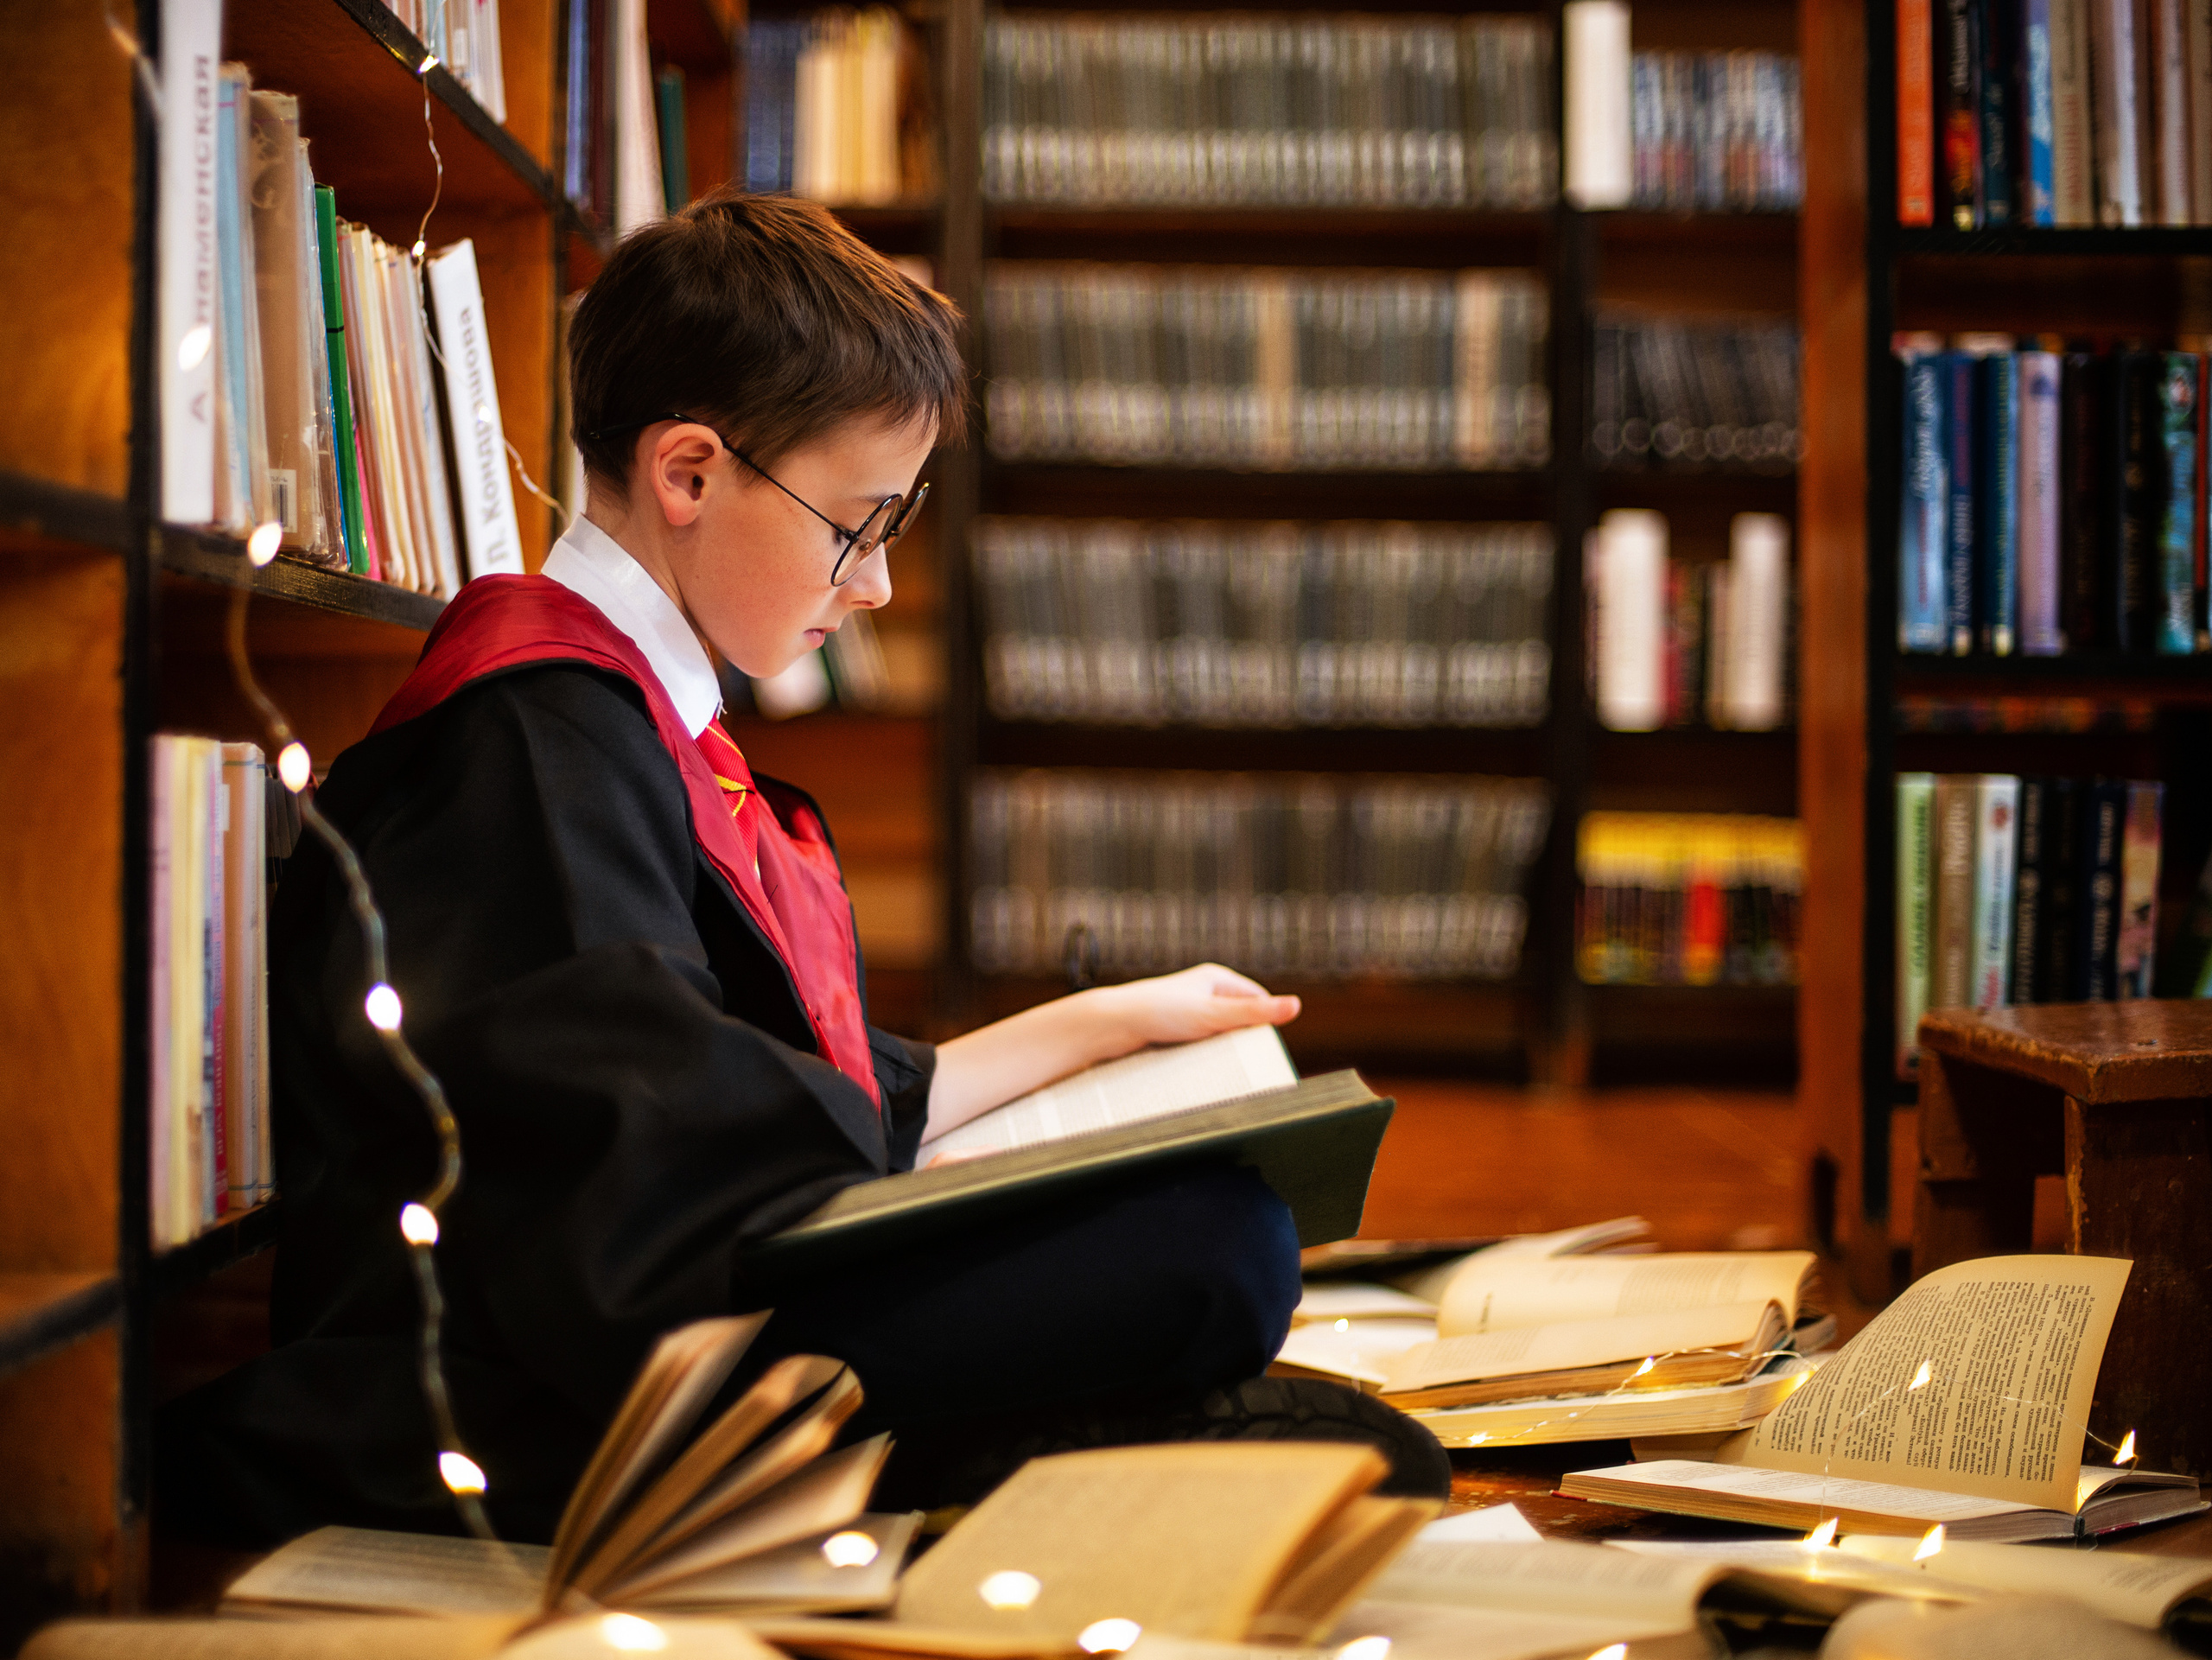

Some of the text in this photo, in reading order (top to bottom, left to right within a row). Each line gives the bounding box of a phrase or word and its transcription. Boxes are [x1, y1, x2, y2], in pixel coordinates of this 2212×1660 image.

[192, 54, 213, 328] наменская
[2036, 1283, 2049, 1311] Шевченко
[2076, 1285, 2084, 1294] На
[2067, 1298, 2079, 1326] страницах
[2078, 1297, 2087, 1313] поэта
[2037, 1317, 2045, 1331] 1857
[2069, 1321, 2079, 1341] одного
[2078, 1304, 2091, 1338] «Дневнике»
[1970, 1343, 1980, 1357] буду
[2031, 1332, 2039, 1347] года,
[1965, 1358, 1974, 1377] делать
[2069, 1340, 2080, 1370] отразился
[1990, 1362, 2001, 1392] достойной
[2005, 1356, 2018, 1387] голеньким
[2039, 1368, 2050, 1400] различных
[2047, 1373, 2056, 1393] между
[2062, 1372, 2071, 1400] широкий
[1923, 1404, 1934, 1445] подержанной
[1931, 1396, 1942, 1436] образцовыми
[1938, 1407, 1948, 1434] Прихожу
[1981, 1395, 1993, 1439] сопутствовать
[1999, 1406, 2006, 1415] Из
[1906, 1402, 1920, 1465] казармах! Эстетика!
[2024, 1408, 2034, 1445] художников
[2030, 1407, 2042, 1450] произведений
[2052, 1420, 2061, 1452] интересов
[1871, 1433, 1880, 1461] Уральска
[1973, 1441, 1978, 1449] же
[1990, 1437, 2000, 1475] библиотеки,
[2035, 1433, 2044, 1466] встречаем
